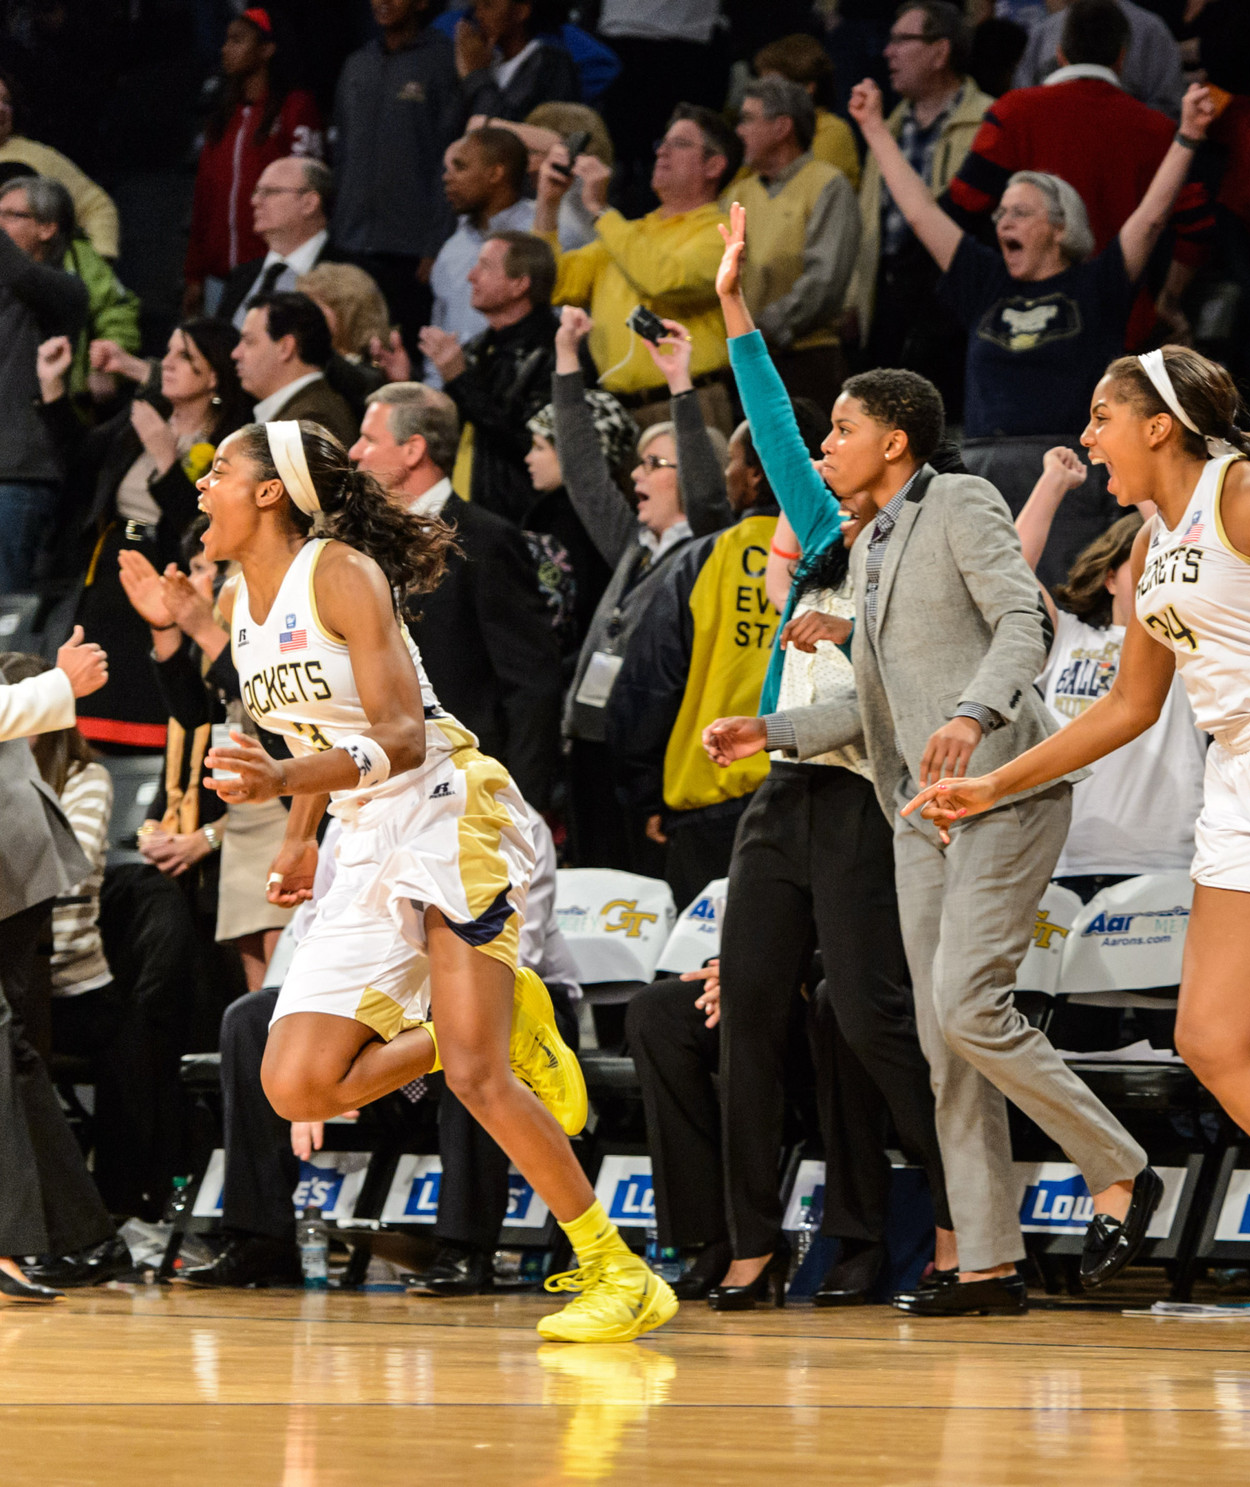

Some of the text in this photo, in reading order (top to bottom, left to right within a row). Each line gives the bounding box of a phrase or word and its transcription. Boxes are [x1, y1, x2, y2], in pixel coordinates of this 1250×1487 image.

[736, 586, 782, 615] EV
[243, 660, 332, 722] ACKETS
[1101, 934, 1172, 947] Aarons.com
[1032, 1189, 1095, 1222] LOW
